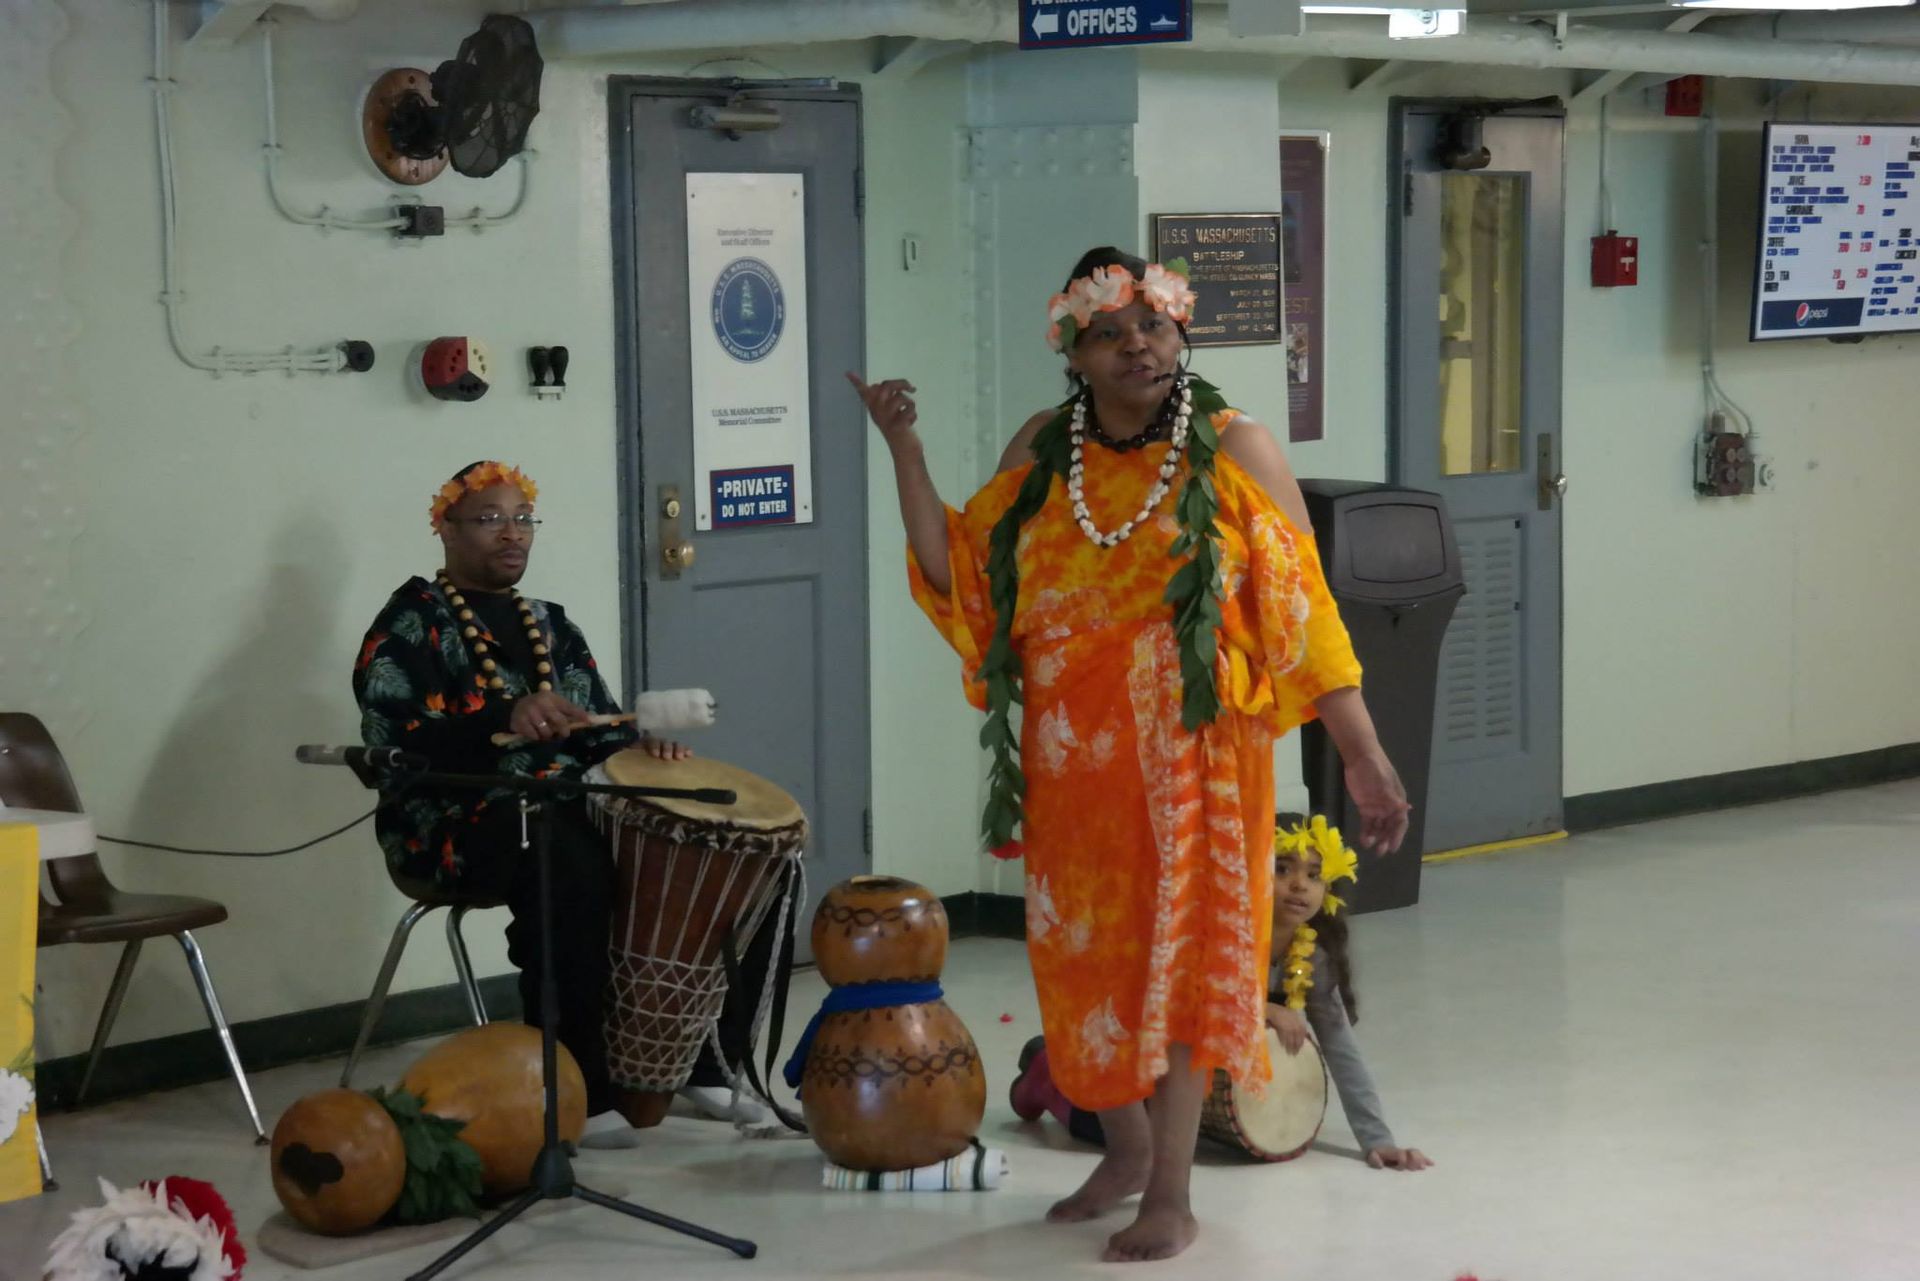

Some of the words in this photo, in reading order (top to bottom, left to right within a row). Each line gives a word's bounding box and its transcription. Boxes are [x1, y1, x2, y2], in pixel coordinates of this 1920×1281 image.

[1067, 6, 1137, 36] OFFICES
[1196, 227, 1276, 243] MASSACHUSETTS
[722, 504, 734, 518] DO
[738, 502, 755, 516] NOT
[759, 500, 787, 514] ENTER
